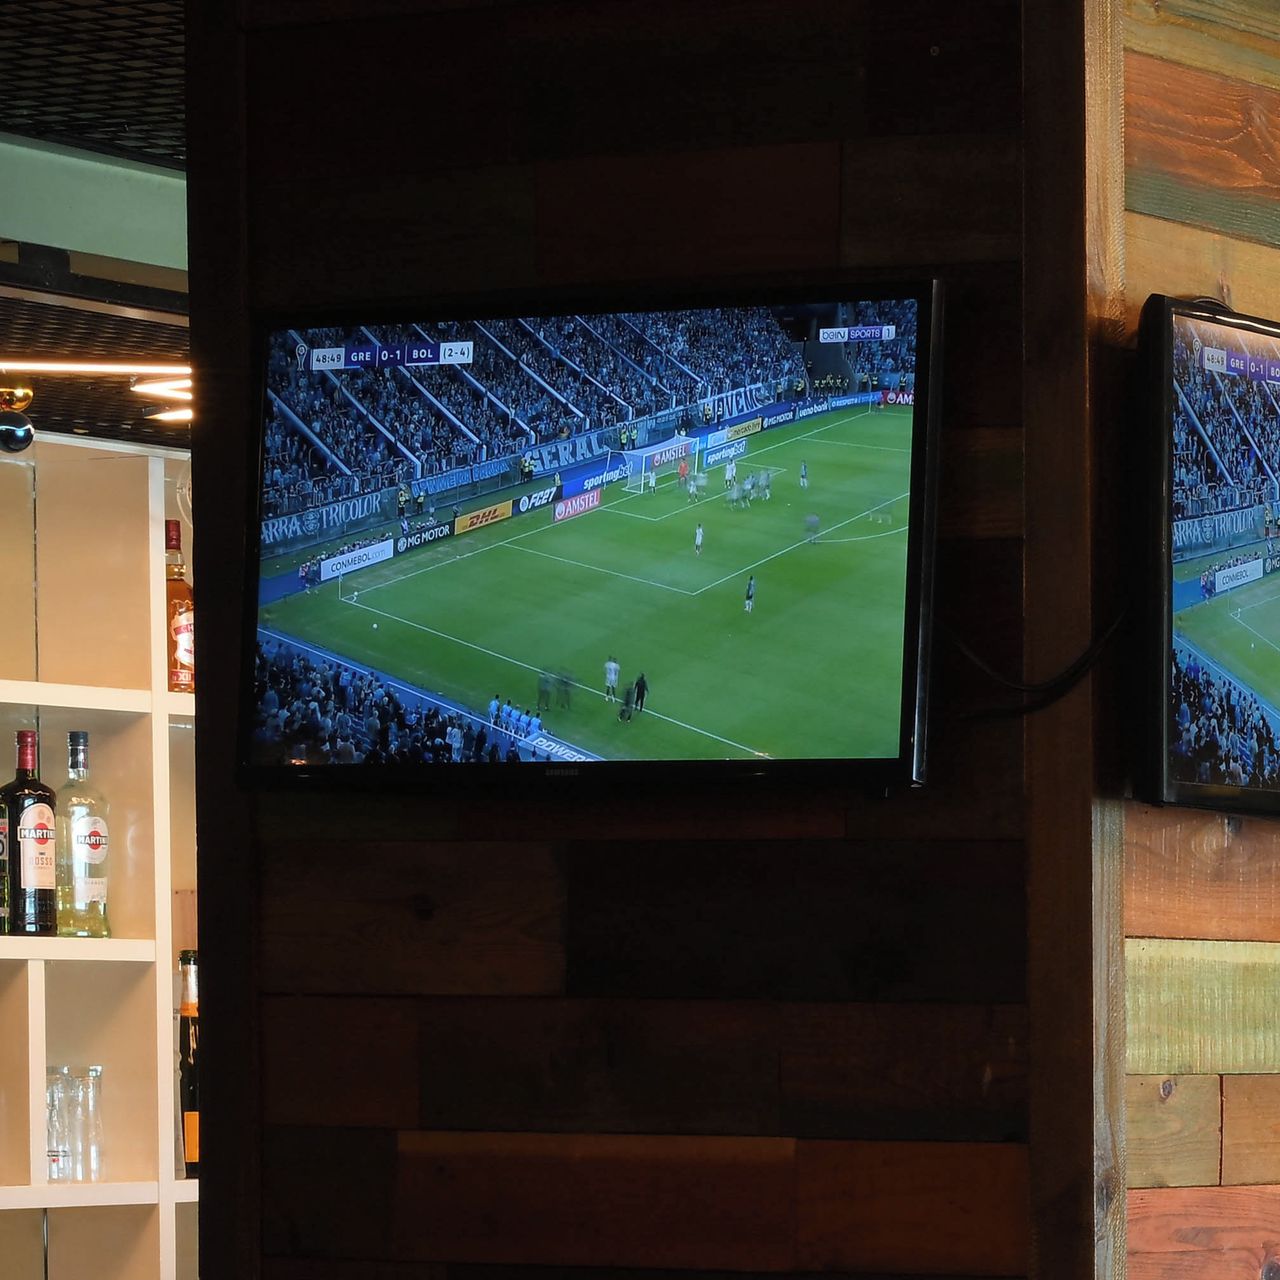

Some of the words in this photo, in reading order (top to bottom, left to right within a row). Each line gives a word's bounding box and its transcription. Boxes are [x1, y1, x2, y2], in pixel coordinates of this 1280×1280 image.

[850, 329, 880, 339] SPORTS
[315, 353, 342, 364] 48:49
[351, 352, 371, 362] GRE
[381, 350, 401, 361] 0-1
[412, 349, 433, 359] BOL
[443, 347, 470, 360] (2-4)
[1230, 358, 1244, 369] GRE
[1250, 362, 1263, 374] 0-1
[661, 446, 686, 463] AMSTEL
[584, 462, 633, 490] sportingbet
[320, 493, 381, 529] TRICOLOR
[565, 491, 599, 514] AMSTEL
[468, 508, 499, 528] DHL
[1213, 510, 1254, 538] TRICOLOR
[407, 533, 420, 547] MG
[421, 524, 450, 544] MOTOR
